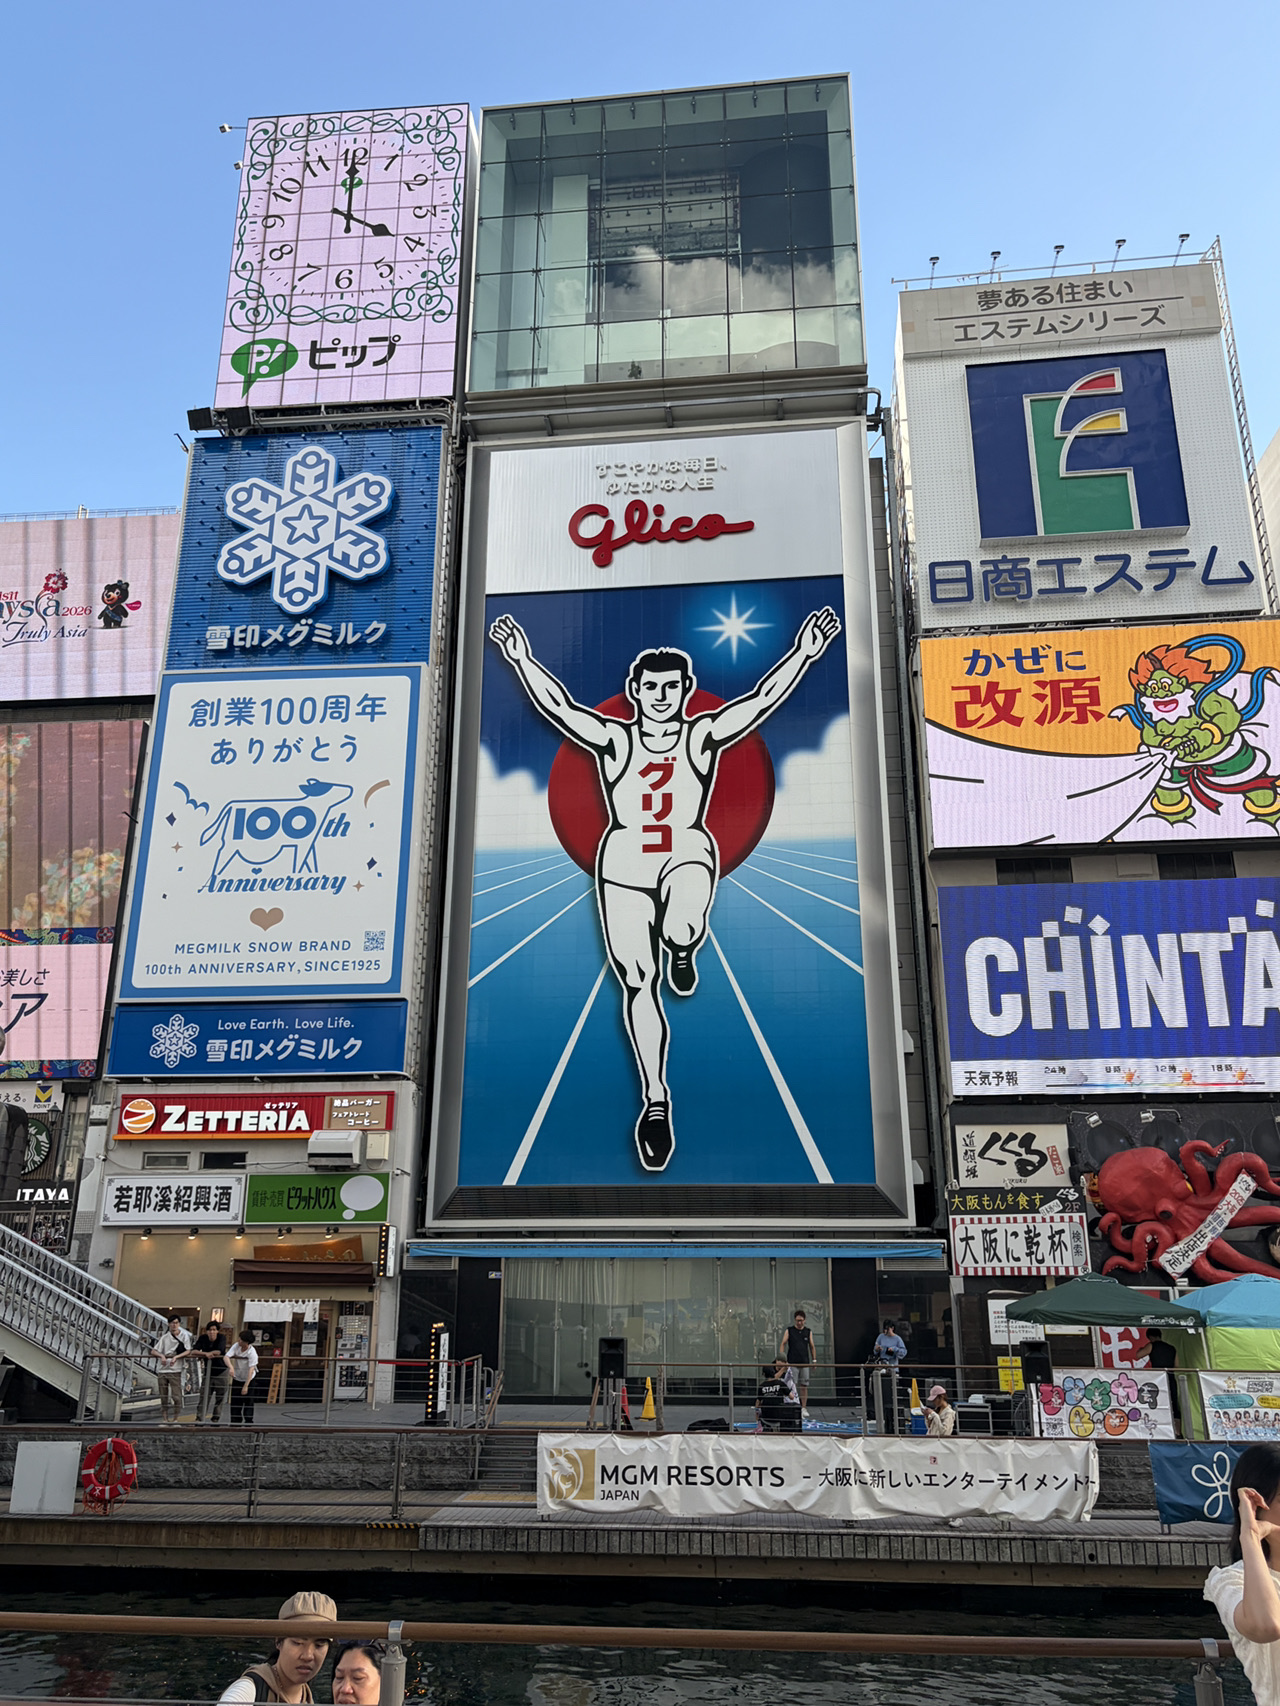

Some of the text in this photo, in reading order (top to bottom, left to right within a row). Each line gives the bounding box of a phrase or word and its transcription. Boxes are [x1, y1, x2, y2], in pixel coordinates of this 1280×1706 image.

[303, 156, 331, 178] 11
[340, 148, 368, 166] 12
[384, 154, 399, 172] 1
[272, 177, 302, 202] 10
[404, 173, 428, 191] 2
[261, 214, 284, 229] 9
[413, 205, 437, 219] 3
[269, 244, 293, 261] 8
[403, 235, 426, 252] 4
[298, 263, 322, 281] 7
[374, 257, 393, 278] 5
[335, 269, 353, 289] 6
[977, 280, 1133, 311] 夢ある住まい
[954, 304, 1166, 342] エステムシリーズ
[309, 334, 401, 369] ピップ
[606, 476, 714, 496] ゆたかな人生
[928, 545, 1254, 604] 日商エステム
[62, 606, 92, 616] 2026
[2, 622, 87, 644] Truly Asia
[206, 618, 386, 649] 雪印メグミルク
[964, 645, 1086, 676] かぜに
[188, 693, 387, 728] 創業100周年
[951, 676, 1106, 729] 改源
[210, 734, 358, 765] ありがとう
[638, 757, 676, 853] グリコ
[197, 874, 347, 895] Anniversary
[175, 940, 351, 954] MEGMILK SNOW BRAND
[0, 968, 50, 987] 美しさ
[145, 964, 182, 975] 100th
[188, 962, 301, 974] ANNIVERSARY,
[0, 993, 48, 1034] ア
[218, 1017, 354, 1030] Love Earth. Love Life.
[206, 1034, 363, 1062] 雪印メグミルク
[964, 1071, 1018, 1086] 天気予報
[0, 1092, 26, 1102] える。
[160, 1105, 310, 1132] ZETTERIA
[978, 1132, 1048, 1177] くくる
[951, 1192, 1044, 1211] 大阪もんを食す
[1065, 1202, 1080, 1212] 2F
[959, 1224, 1068, 1265] 大阪に乾杯
[1072, 1229, 1083, 1257] 検索
[1166, 1230, 1208, 1270] 出店決定
[762, 1385, 780, 1394] STAFF
[600, 1465, 657, 1485] MGM
[667, 1466, 784, 1487] RESORTS
[600, 1490, 639, 1500] JAPAN
